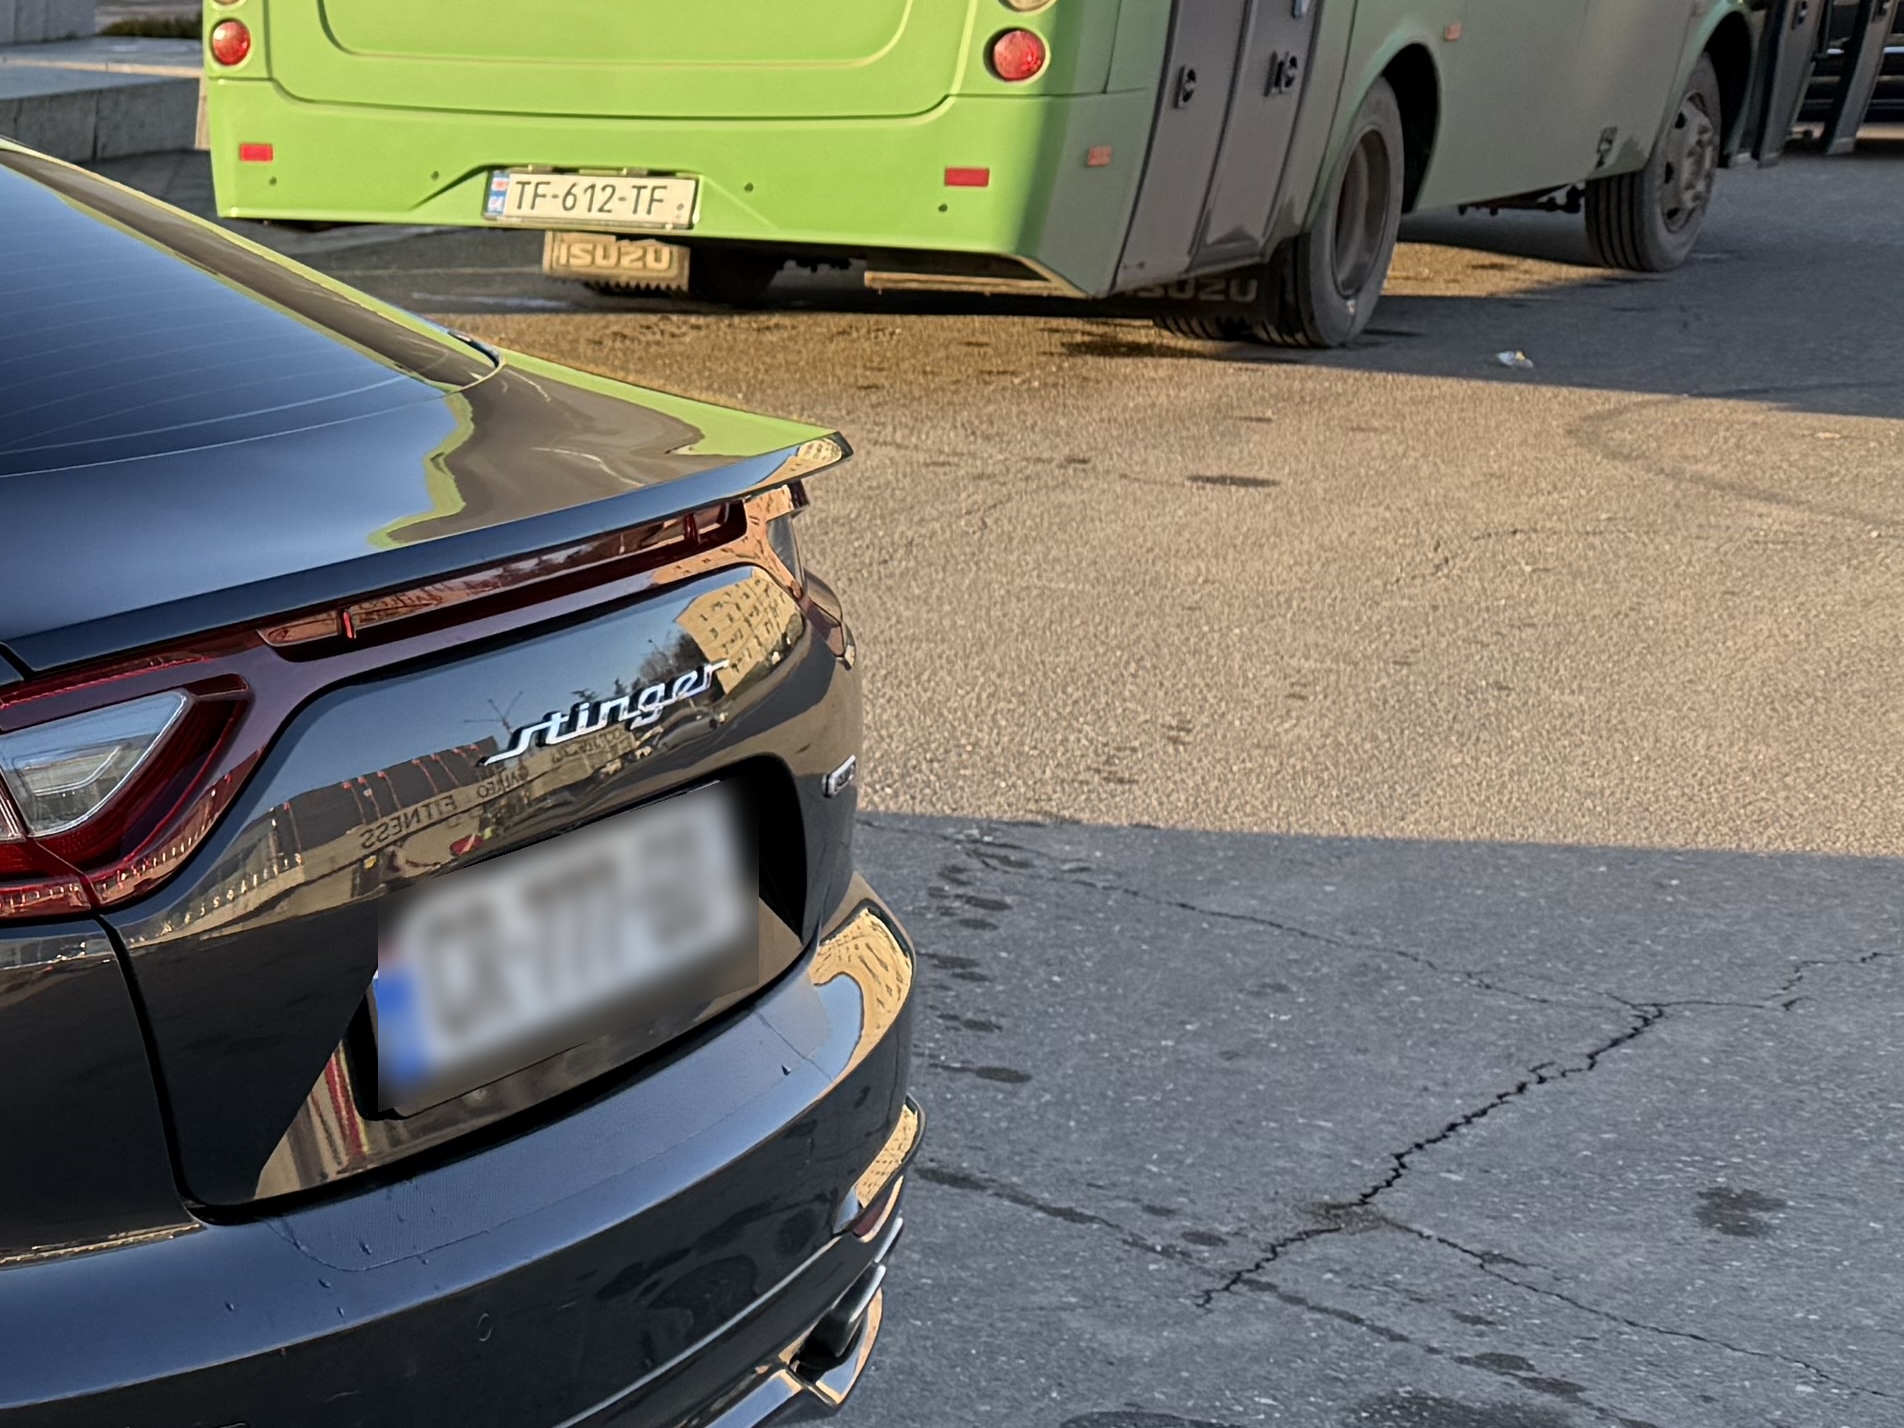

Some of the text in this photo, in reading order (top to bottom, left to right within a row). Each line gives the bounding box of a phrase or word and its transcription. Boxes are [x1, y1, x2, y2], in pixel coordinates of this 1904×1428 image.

[515, 180, 668, 216] TF-612-TF
[558, 242, 671, 271] ISUZU
[1135, 277, 1259, 303] SUZU
